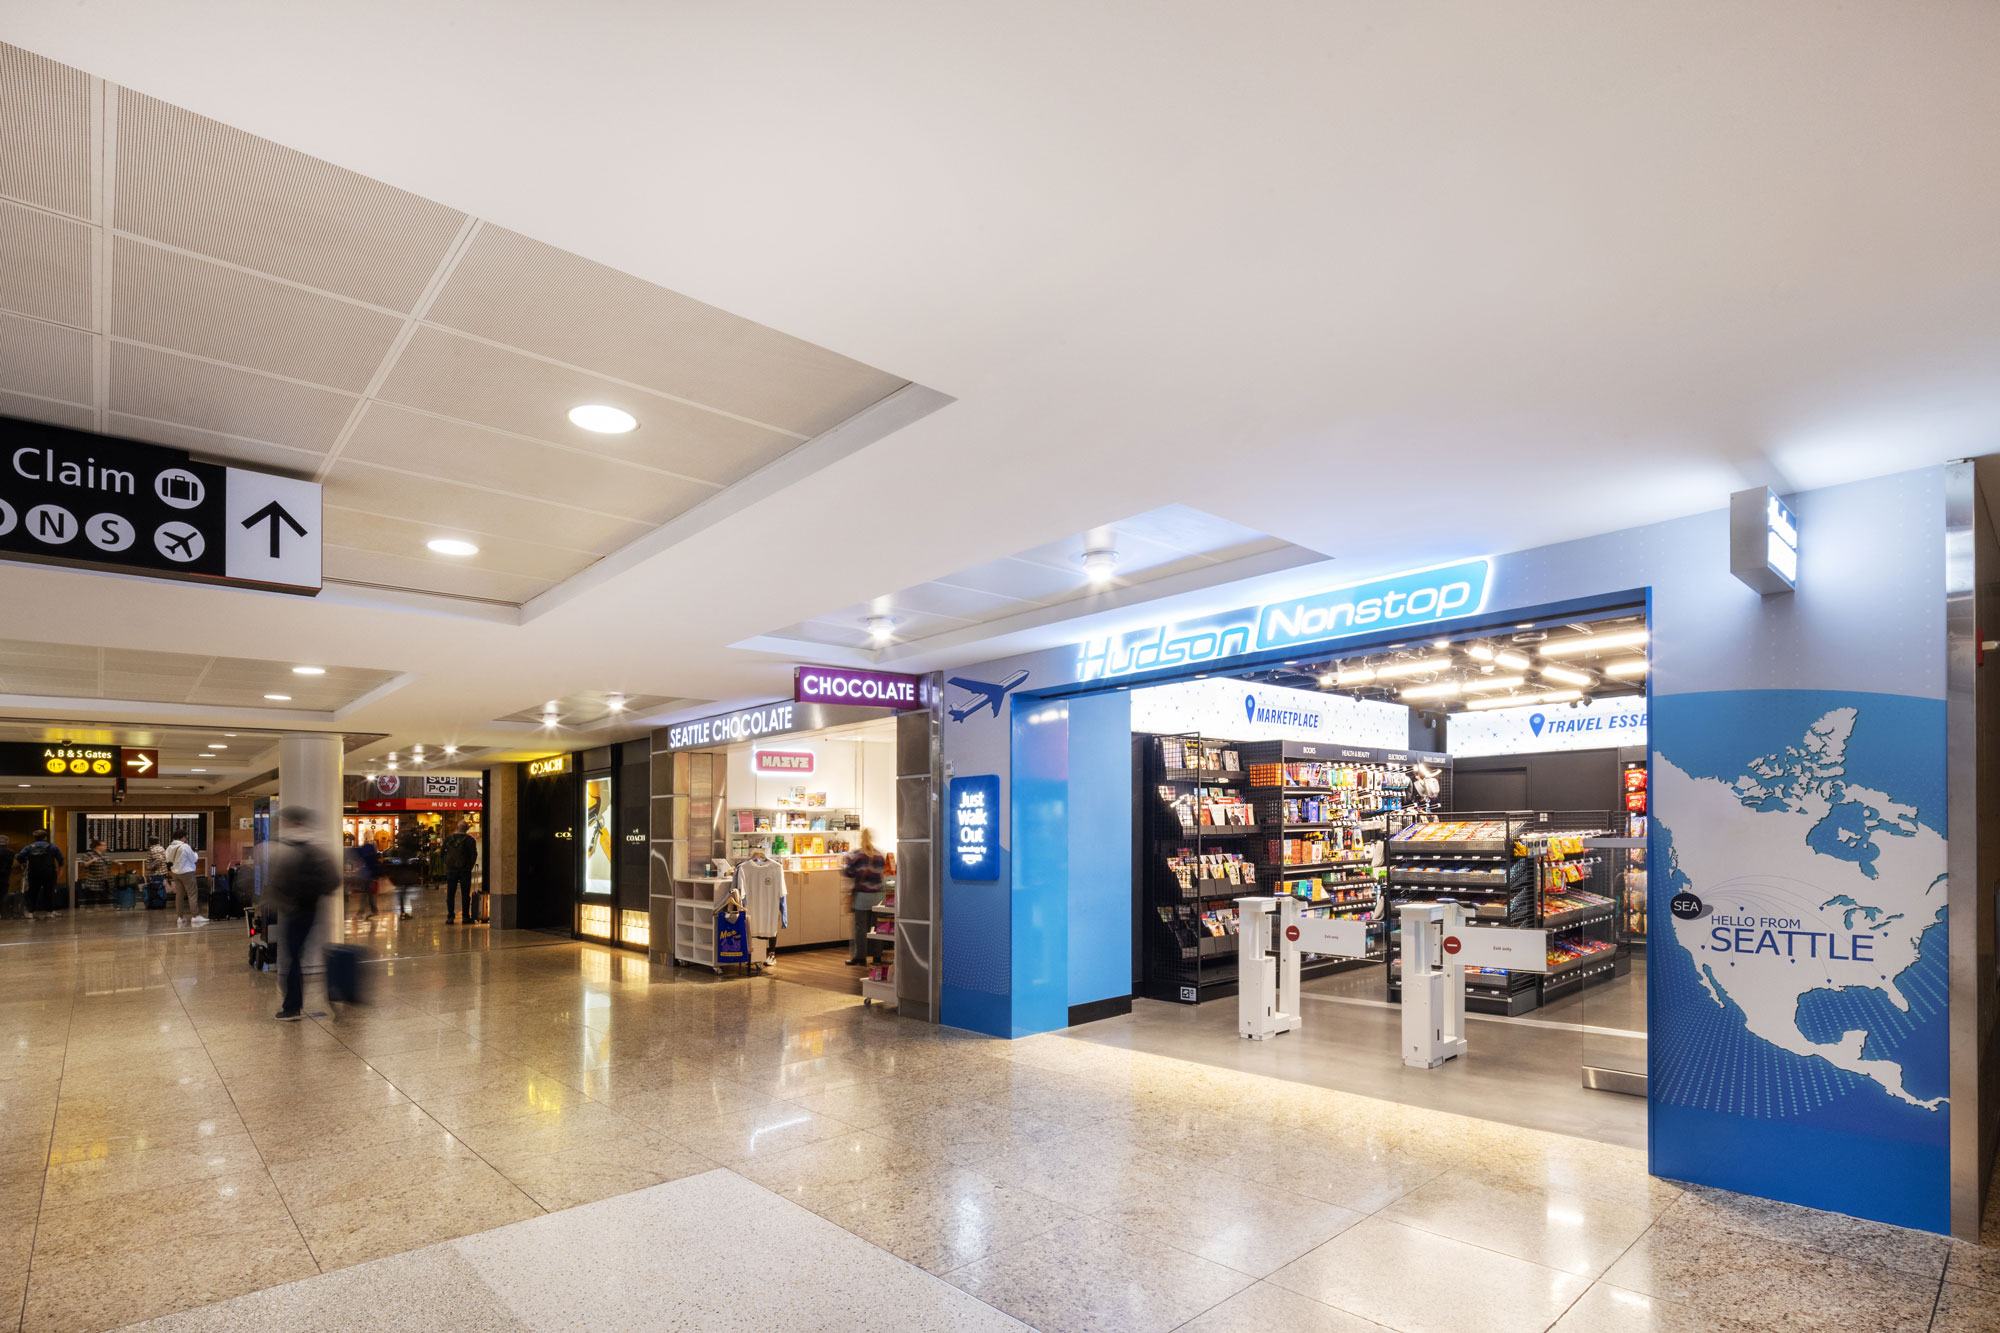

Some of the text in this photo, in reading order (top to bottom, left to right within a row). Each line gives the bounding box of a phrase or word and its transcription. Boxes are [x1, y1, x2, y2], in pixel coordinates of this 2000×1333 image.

[13, 447, 135, 495] Claim
[39, 510, 120, 545] N S
[1076, 581, 1470, 681] Hudson Nonstop
[803, 675, 914, 700] CHOCOLATE
[1256, 708, 1319, 728] MARKETPLACE
[1548, 717, 1603, 733] TRAVEL
[670, 706, 792, 748] SEATTLE CHOCOLATE
[44, 749, 55, 758] A,
[85, 750, 112, 759] Gates
[1303, 746, 1317, 755] BOOKS
[530, 758, 563, 775] COACH
[762, 755, 809, 768] MAEVE
[959, 792, 984, 808] Just
[957, 808, 987, 826] Walk
[960, 826, 984, 843] Out
[1673, 900, 1699, 912] SEA
[1711, 915, 1801, 930] HELLO FROM
[1711, 926, 1874, 962] SEATTLE
